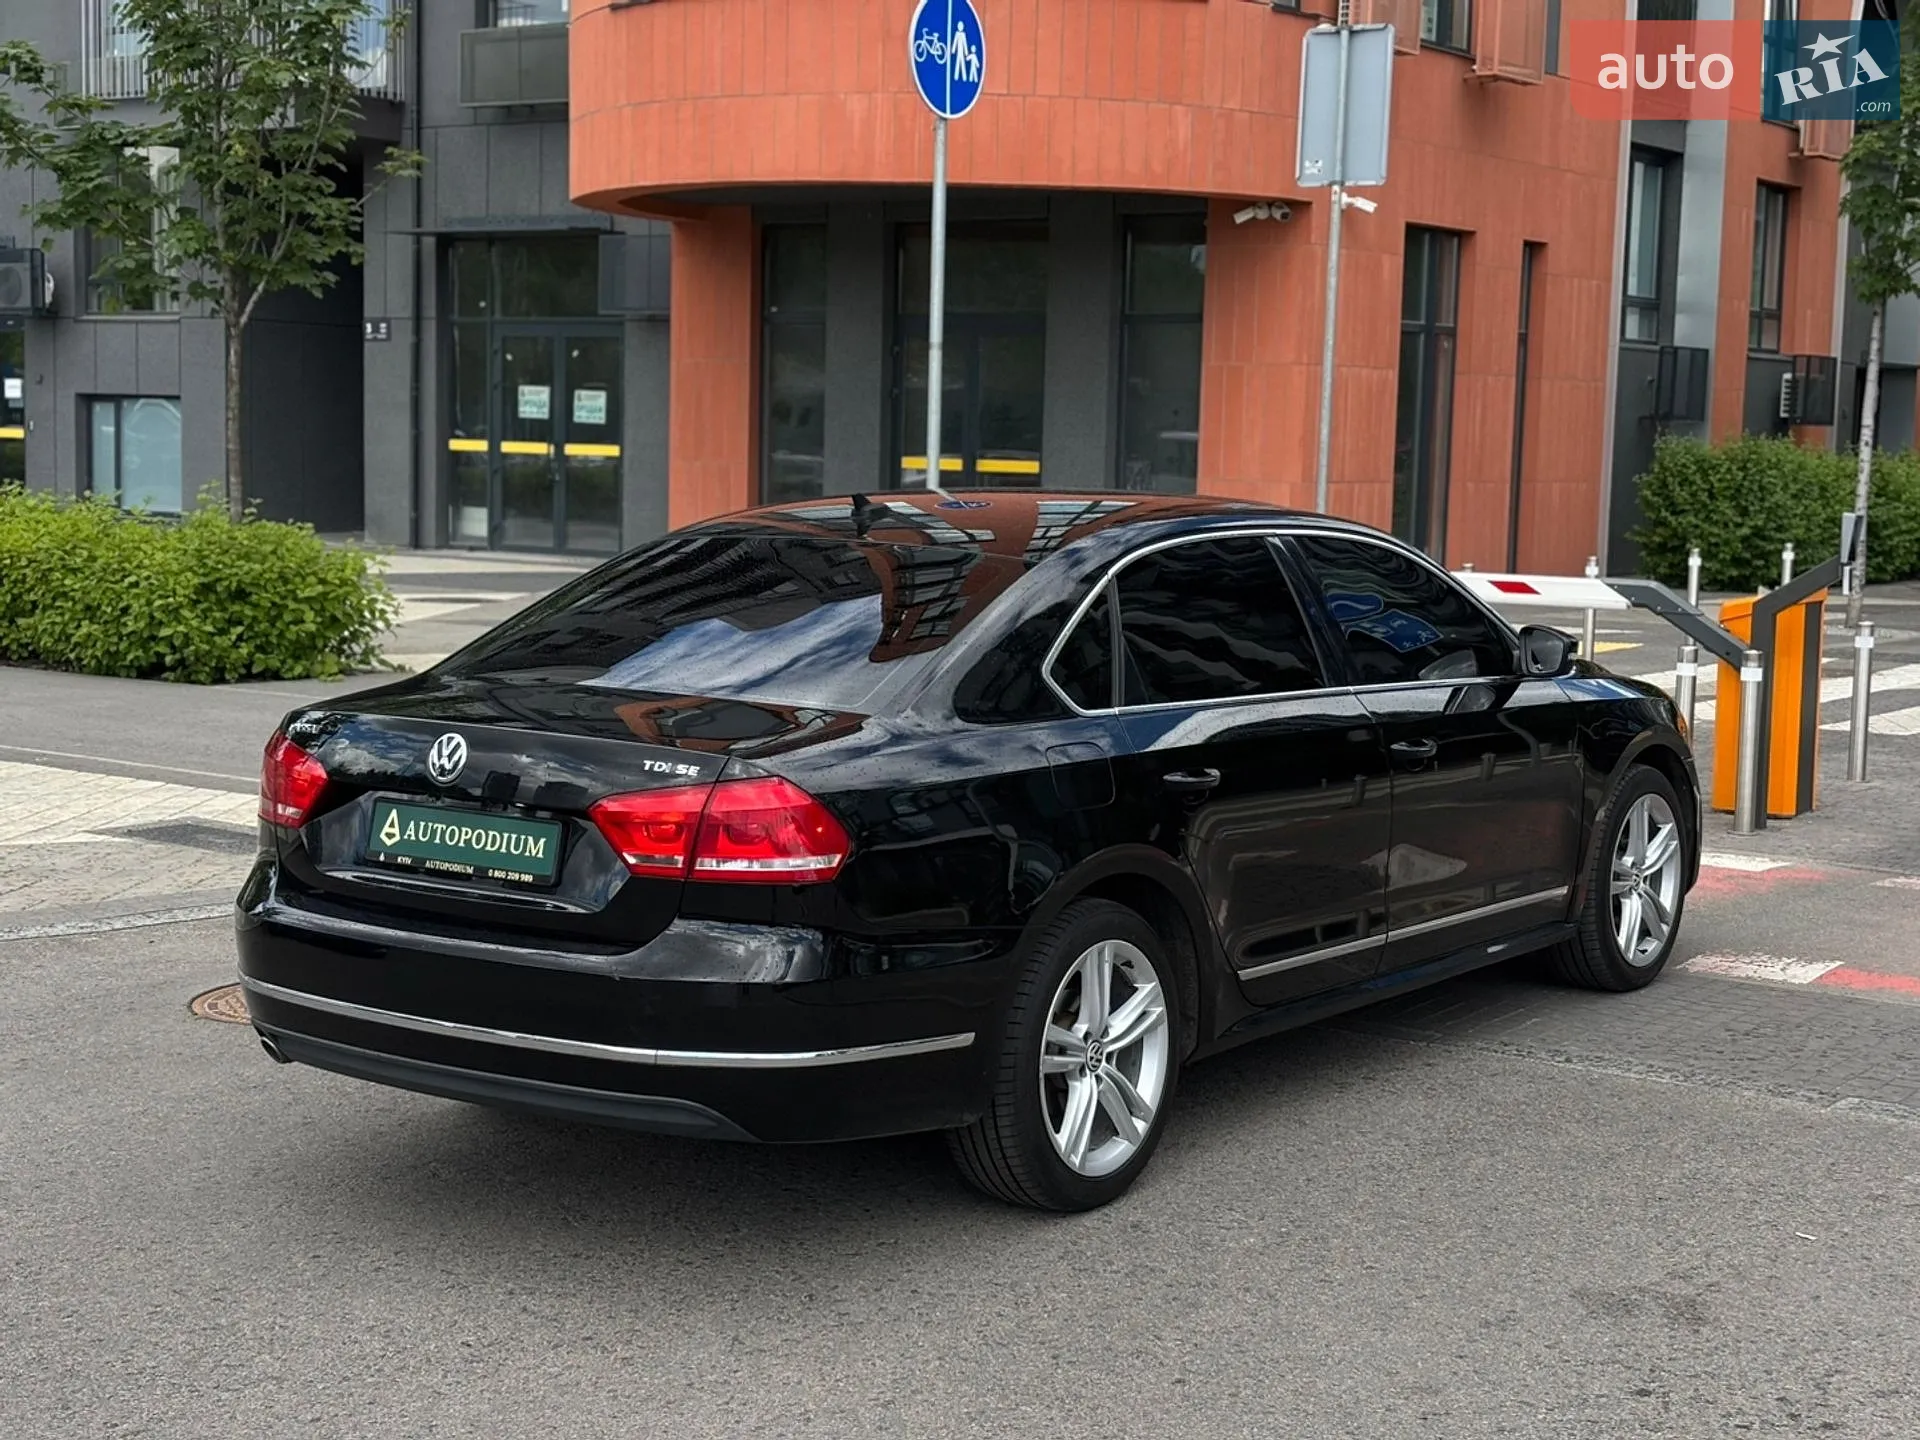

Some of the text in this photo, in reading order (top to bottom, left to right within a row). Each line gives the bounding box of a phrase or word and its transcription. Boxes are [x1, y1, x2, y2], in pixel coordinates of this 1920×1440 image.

[643, 760, 700, 777] TDI SE
[403, 820, 547, 859] AUTOPODIUM
[397, 856, 412, 865] KYIV
[425, 860, 474, 875] AUTOPODIUM
